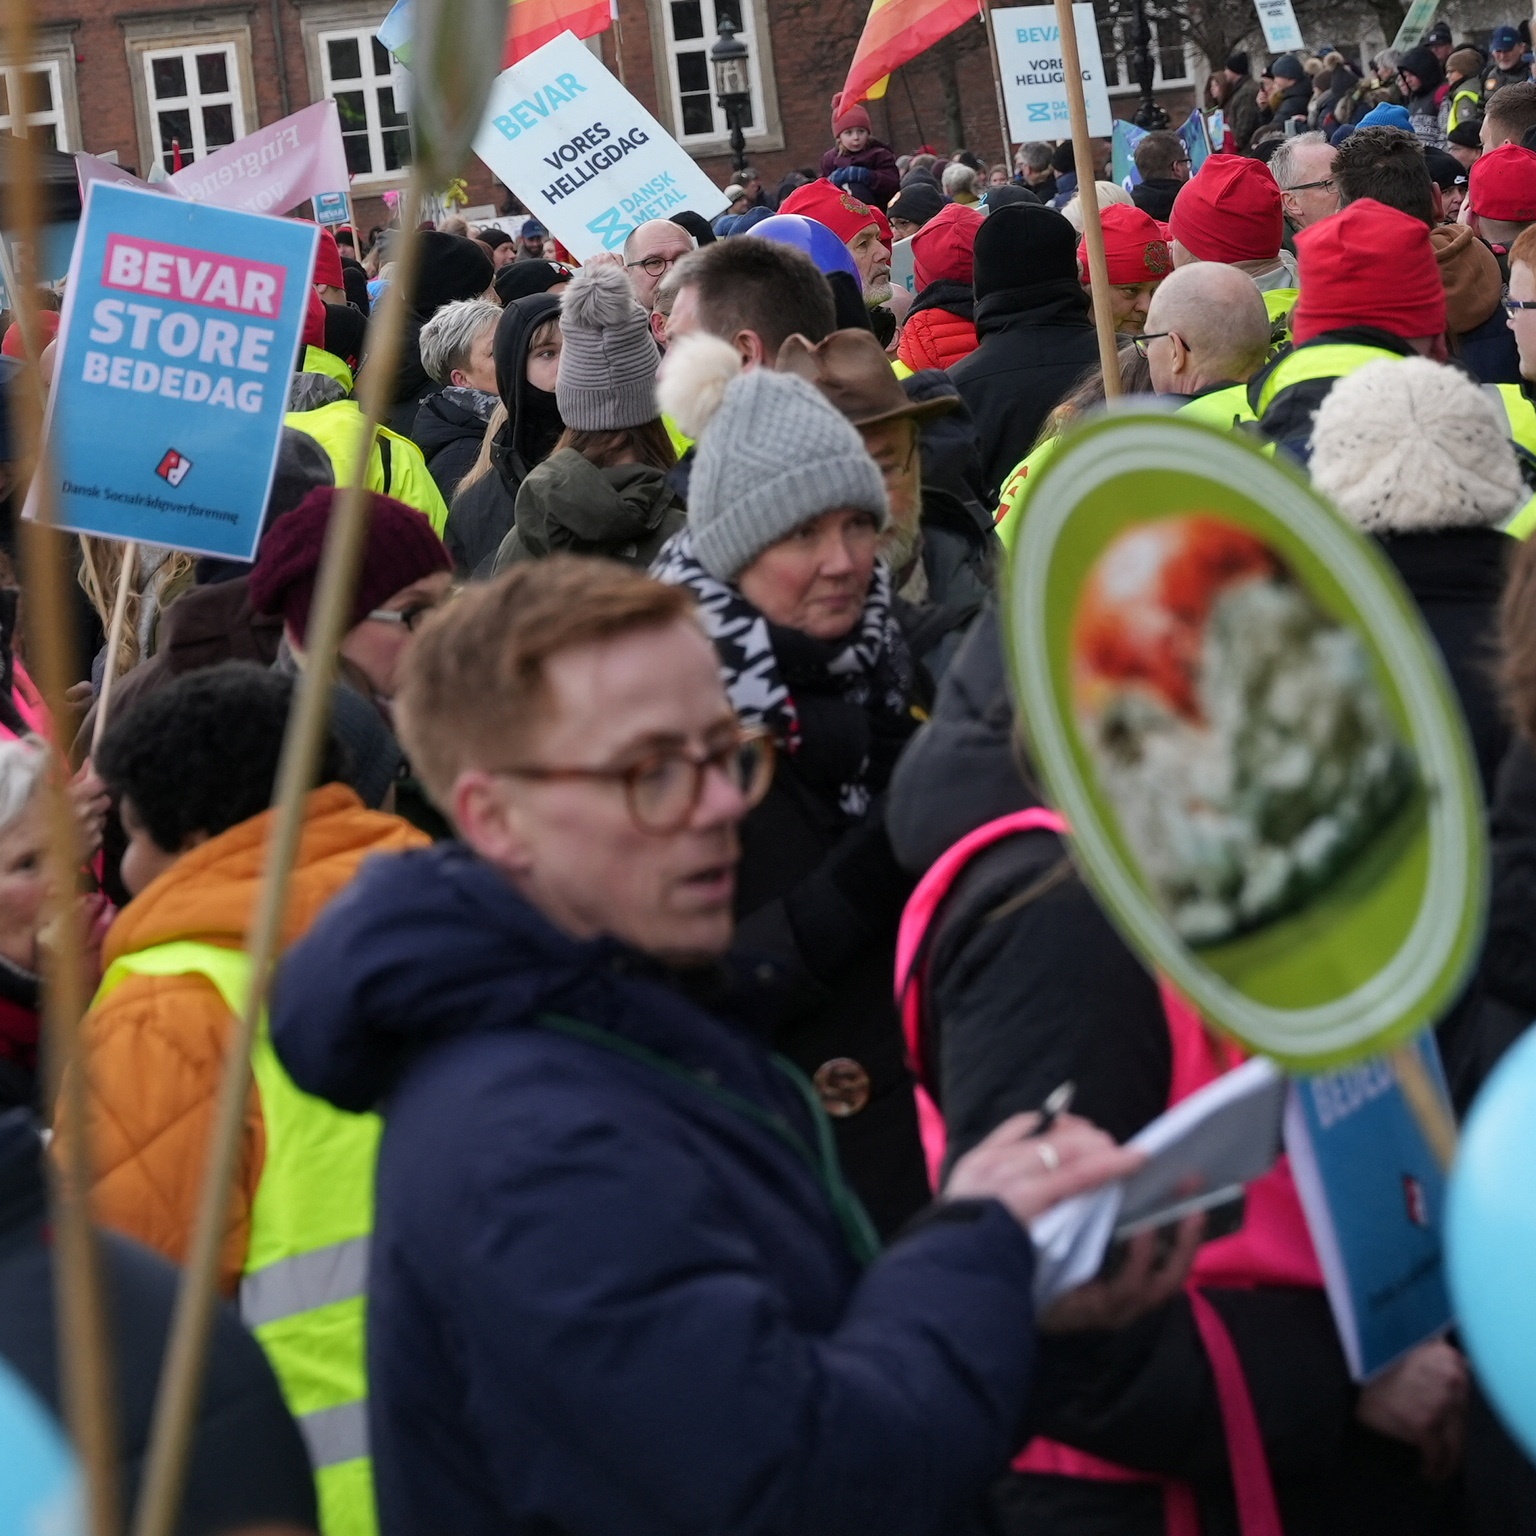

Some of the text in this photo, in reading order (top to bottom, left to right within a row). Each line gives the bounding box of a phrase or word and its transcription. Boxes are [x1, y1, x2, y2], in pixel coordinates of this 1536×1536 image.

[1016, 26, 1061, 43] BEVA
[1016, 70, 1092, 86] HELLIGG
[1029, 59, 1063, 71] VORE
[492, 72, 588, 141] BEVAR
[541, 127, 650, 205] HELLIGDAG
[543, 122, 611, 171] VORES
[619, 170, 677, 214] DANSK
[632, 187, 688, 223] METAL
[108, 244, 277, 314] BEVAR
[89, 298, 275, 373] STORE
[81, 351, 263, 413] BEDEDAG
[61, 480, 101, 499] Dansk
